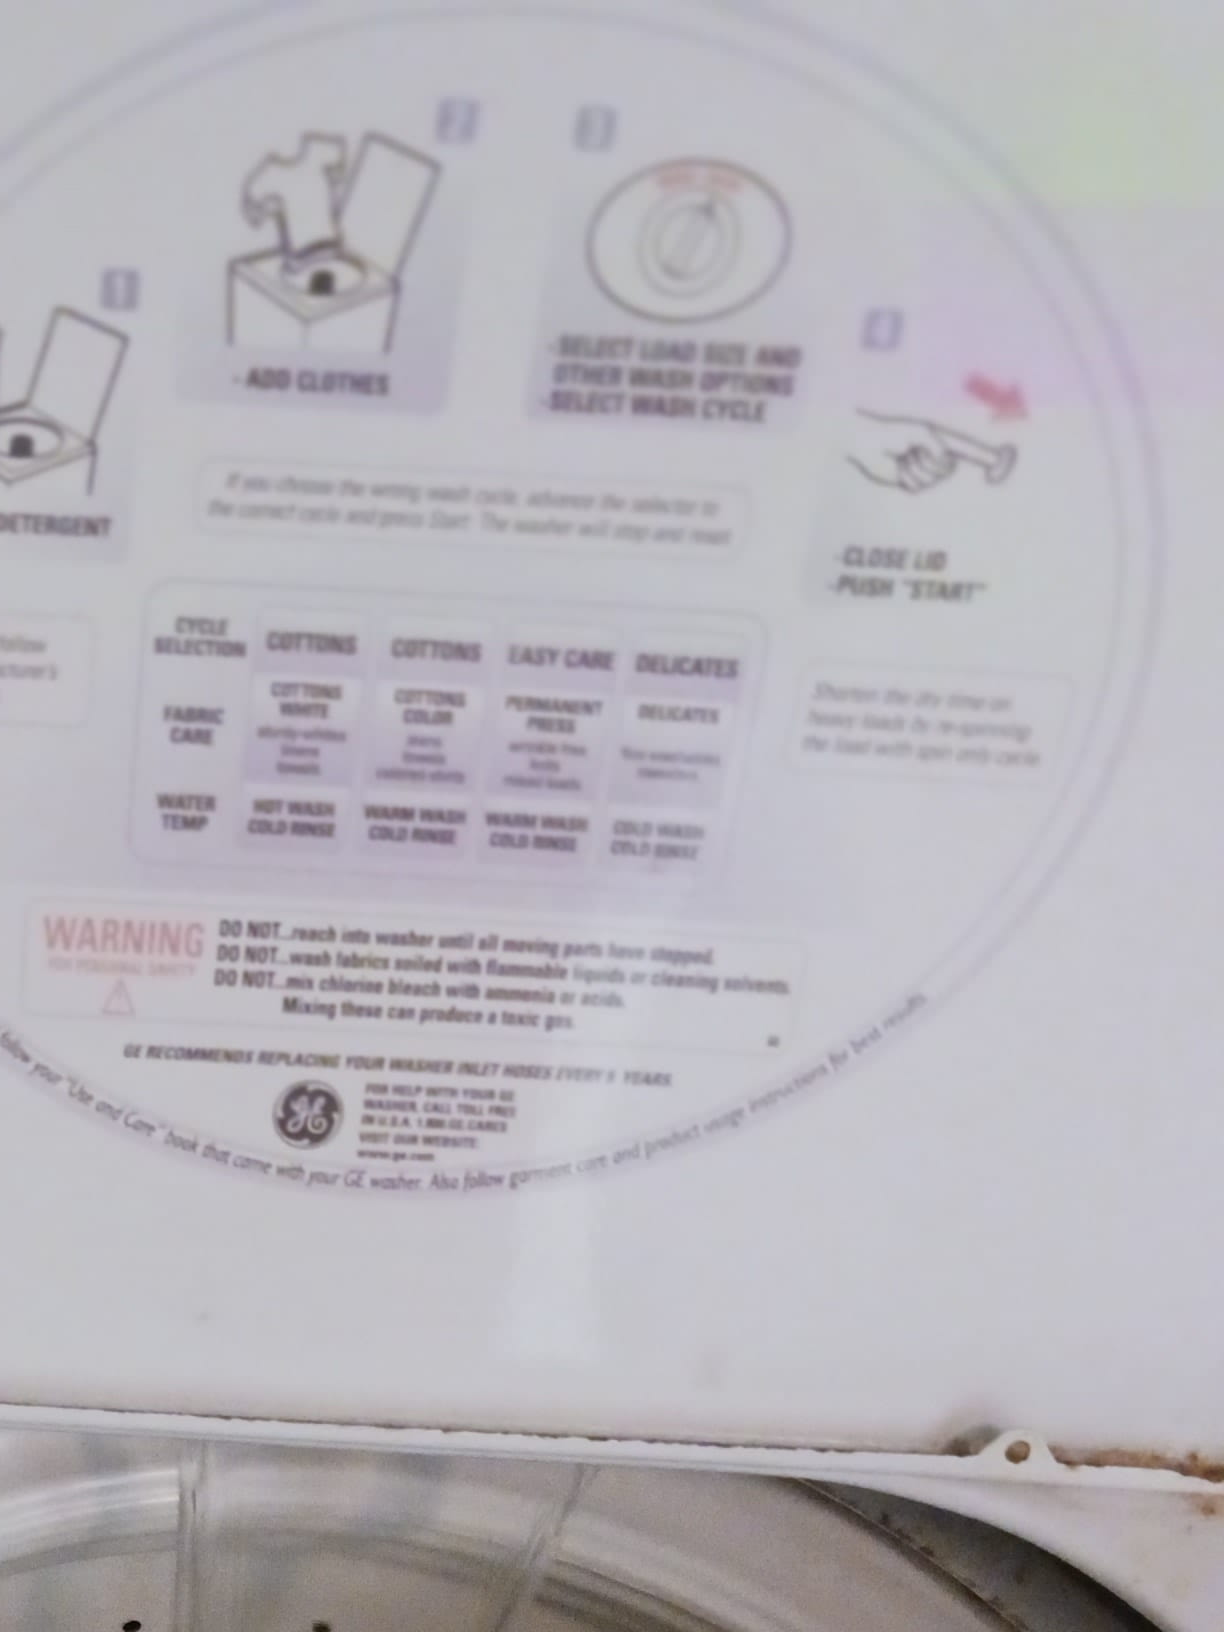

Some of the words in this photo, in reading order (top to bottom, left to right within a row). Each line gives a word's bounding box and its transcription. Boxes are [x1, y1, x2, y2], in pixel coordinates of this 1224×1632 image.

[638, 337, 697, 363] LOAD
[703, 339, 747, 366] SIZE
[755, 344, 803, 369] AND
[295, 369, 391, 397] CLOTHES
[553, 361, 623, 387] OTHER
[628, 367, 695, 390] WASH
[698, 371, 795, 398] OPTIONS
[630, 395, 696, 418] WASH
[700, 398, 768, 424] CYCLE
[912, 549, 948, 573] LID
[175, 616, 229, 637] CYCLE
[153, 635, 247, 659] SELECTION
[266, 629, 358, 656] COTTONS
[390, 637, 482, 663] COTTONS
[506, 643, 560, 667] EASY
[563, 647, 616, 672] CARE
[634, 651, 740, 680] DELICATES
[270, 680, 344, 701] COTTONS
[393, 688, 467, 709] COTTONS
[162, 704, 225, 725] FABRIC
[279, 700, 329, 720] WHITE
[402, 707, 454, 726] COLOR
[503, 695, 604, 716] PERMANENT
[637, 703, 721, 725] DELICATES
[169, 725, 215, 746] CARE
[525, 715, 576, 734] PRESS
[155, 793, 217, 812] WATER
[252, 798, 283, 816] HOT
[286, 801, 336, 818] WASH
[161, 813, 209, 832] TEMP
[363, 804, 416, 821] WARM
[418, 808, 467, 825] WASH
[484, 811, 538, 829] WARM
[540, 815, 589, 833] WASH
[247, 818, 288, 836] COLD
[290, 821, 336, 839] RINSE
[368, 824, 409, 843] COLD
[411, 827, 457, 846] RINSE
[612, 819, 653, 838] COLD
[656, 823, 706, 841] WASH
[489, 831, 530, 850] COLD
[532, 835, 578, 854] RINSE
[610, 839, 651, 858] COLD
[653, 842, 701, 862] RINSE
[42, 914, 207, 959] WARNING
[218, 919, 243, 939] DO
[341, 927, 371, 945] into
[375, 930, 434, 948] washer
[437, 931, 475, 950] until
[477, 933, 499, 951] all
[502, 937, 559, 960] moving
[562, 941, 604, 962] parts
[216, 943, 241, 963] DO
[334, 948, 390, 970] fabrics
[393, 954, 442, 974] soiled
[445, 958, 482, 976] with
[485, 957, 569, 981] flammable
[651, 969, 720, 995] cleaning
[213, 968, 238, 988] DO
[317, 973, 384, 995] chlorine
[386, 977, 441, 998] bleach
[444, 983, 481, 999] with
[483, 986, 556, 1005] ammonia
[282, 996, 338, 1021] Mixing
[340, 998, 384, 1020] these
[386, 1005, 416, 1021] can
[418, 1006, 484, 1027] produce
[486, 1011, 498, 1025] a
[500, 1009, 540, 1028] toxic
[122, 1043, 142, 1060] GE
[145, 1044, 254, 1065] RECOMMENDS
[257, 1048, 341, 1069] REPLACING
[344, 1055, 386, 1072] YOUR
[388, 1057, 454, 1076] WASHER
[457, 1060, 500, 1078] INLET
[502, 1062, 553, 1081] HOSES
[555, 1063, 604, 1082] EVERY
[622, 1070, 673, 1088] YEARS
[364, 1082, 389, 1096] FOR
[391, 1084, 423, 1098] HELP
[425, 1085, 459, 1099] WITH
[461, 1087, 496, 1101] YOUR
[422, 1102, 453, 1115] CALL
[456, 1103, 484, 1116] TOLL
[487, 1105, 517, 1118] FREE
[358, 1131, 390, 1145] VISIT
[392, 1133, 419, 1146] OUR
[343, 1168, 368, 1190] GE
[430, 1169, 460, 1191] Also
[462, 1167, 506, 1193] follow
[508, 1161, 573, 1191] garment
[575, 1154, 610, 1174] care
[612, 1142, 641, 1164] and
[644, 1122, 701, 1160] product
